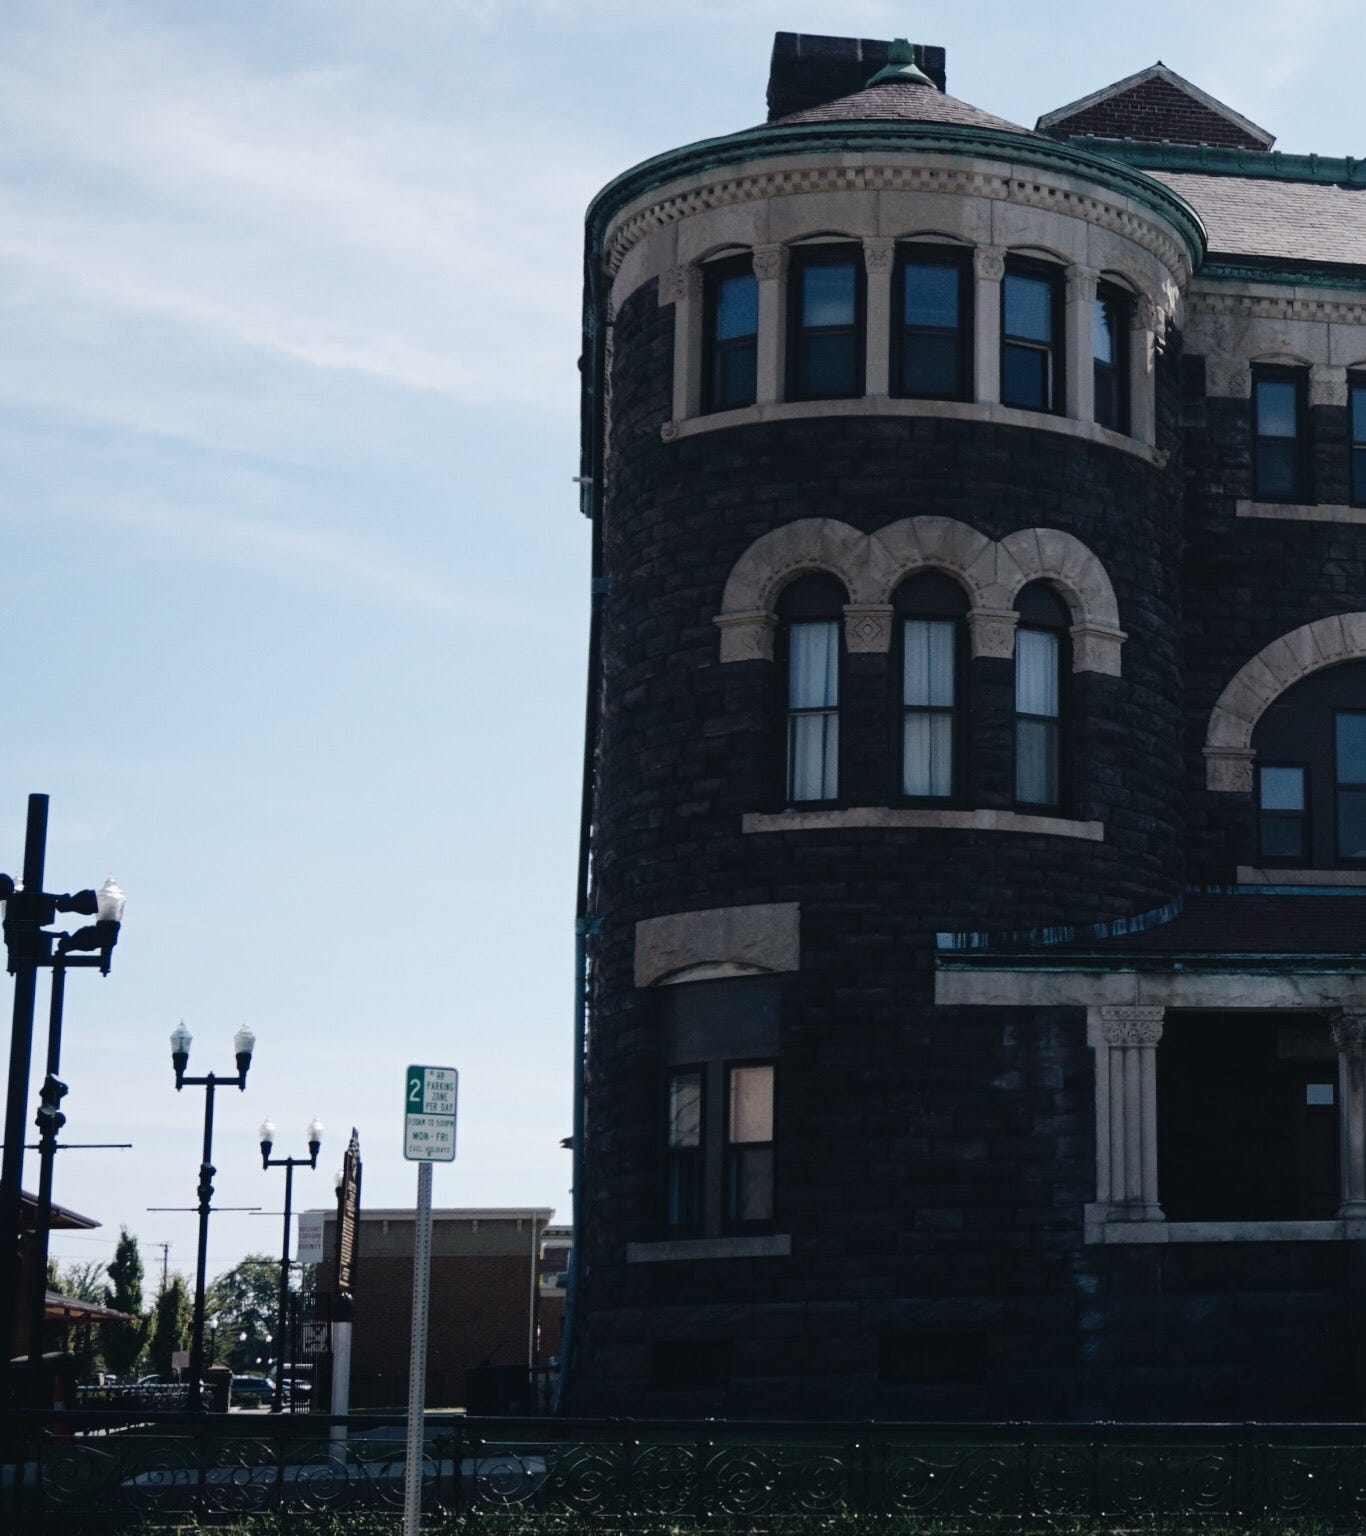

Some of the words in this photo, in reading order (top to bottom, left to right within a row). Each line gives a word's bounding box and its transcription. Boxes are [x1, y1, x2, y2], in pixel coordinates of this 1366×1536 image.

[409, 1079, 421, 1102] 2
[426, 1081, 454, 1091] PARKING
[432, 1091, 448, 1102] ZONE
[425, 1101, 437, 1111] PER
[441, 1102, 453, 1112] DAY
[412, 1131, 429, 1141] MON
[436, 1132, 448, 1142] FRI
